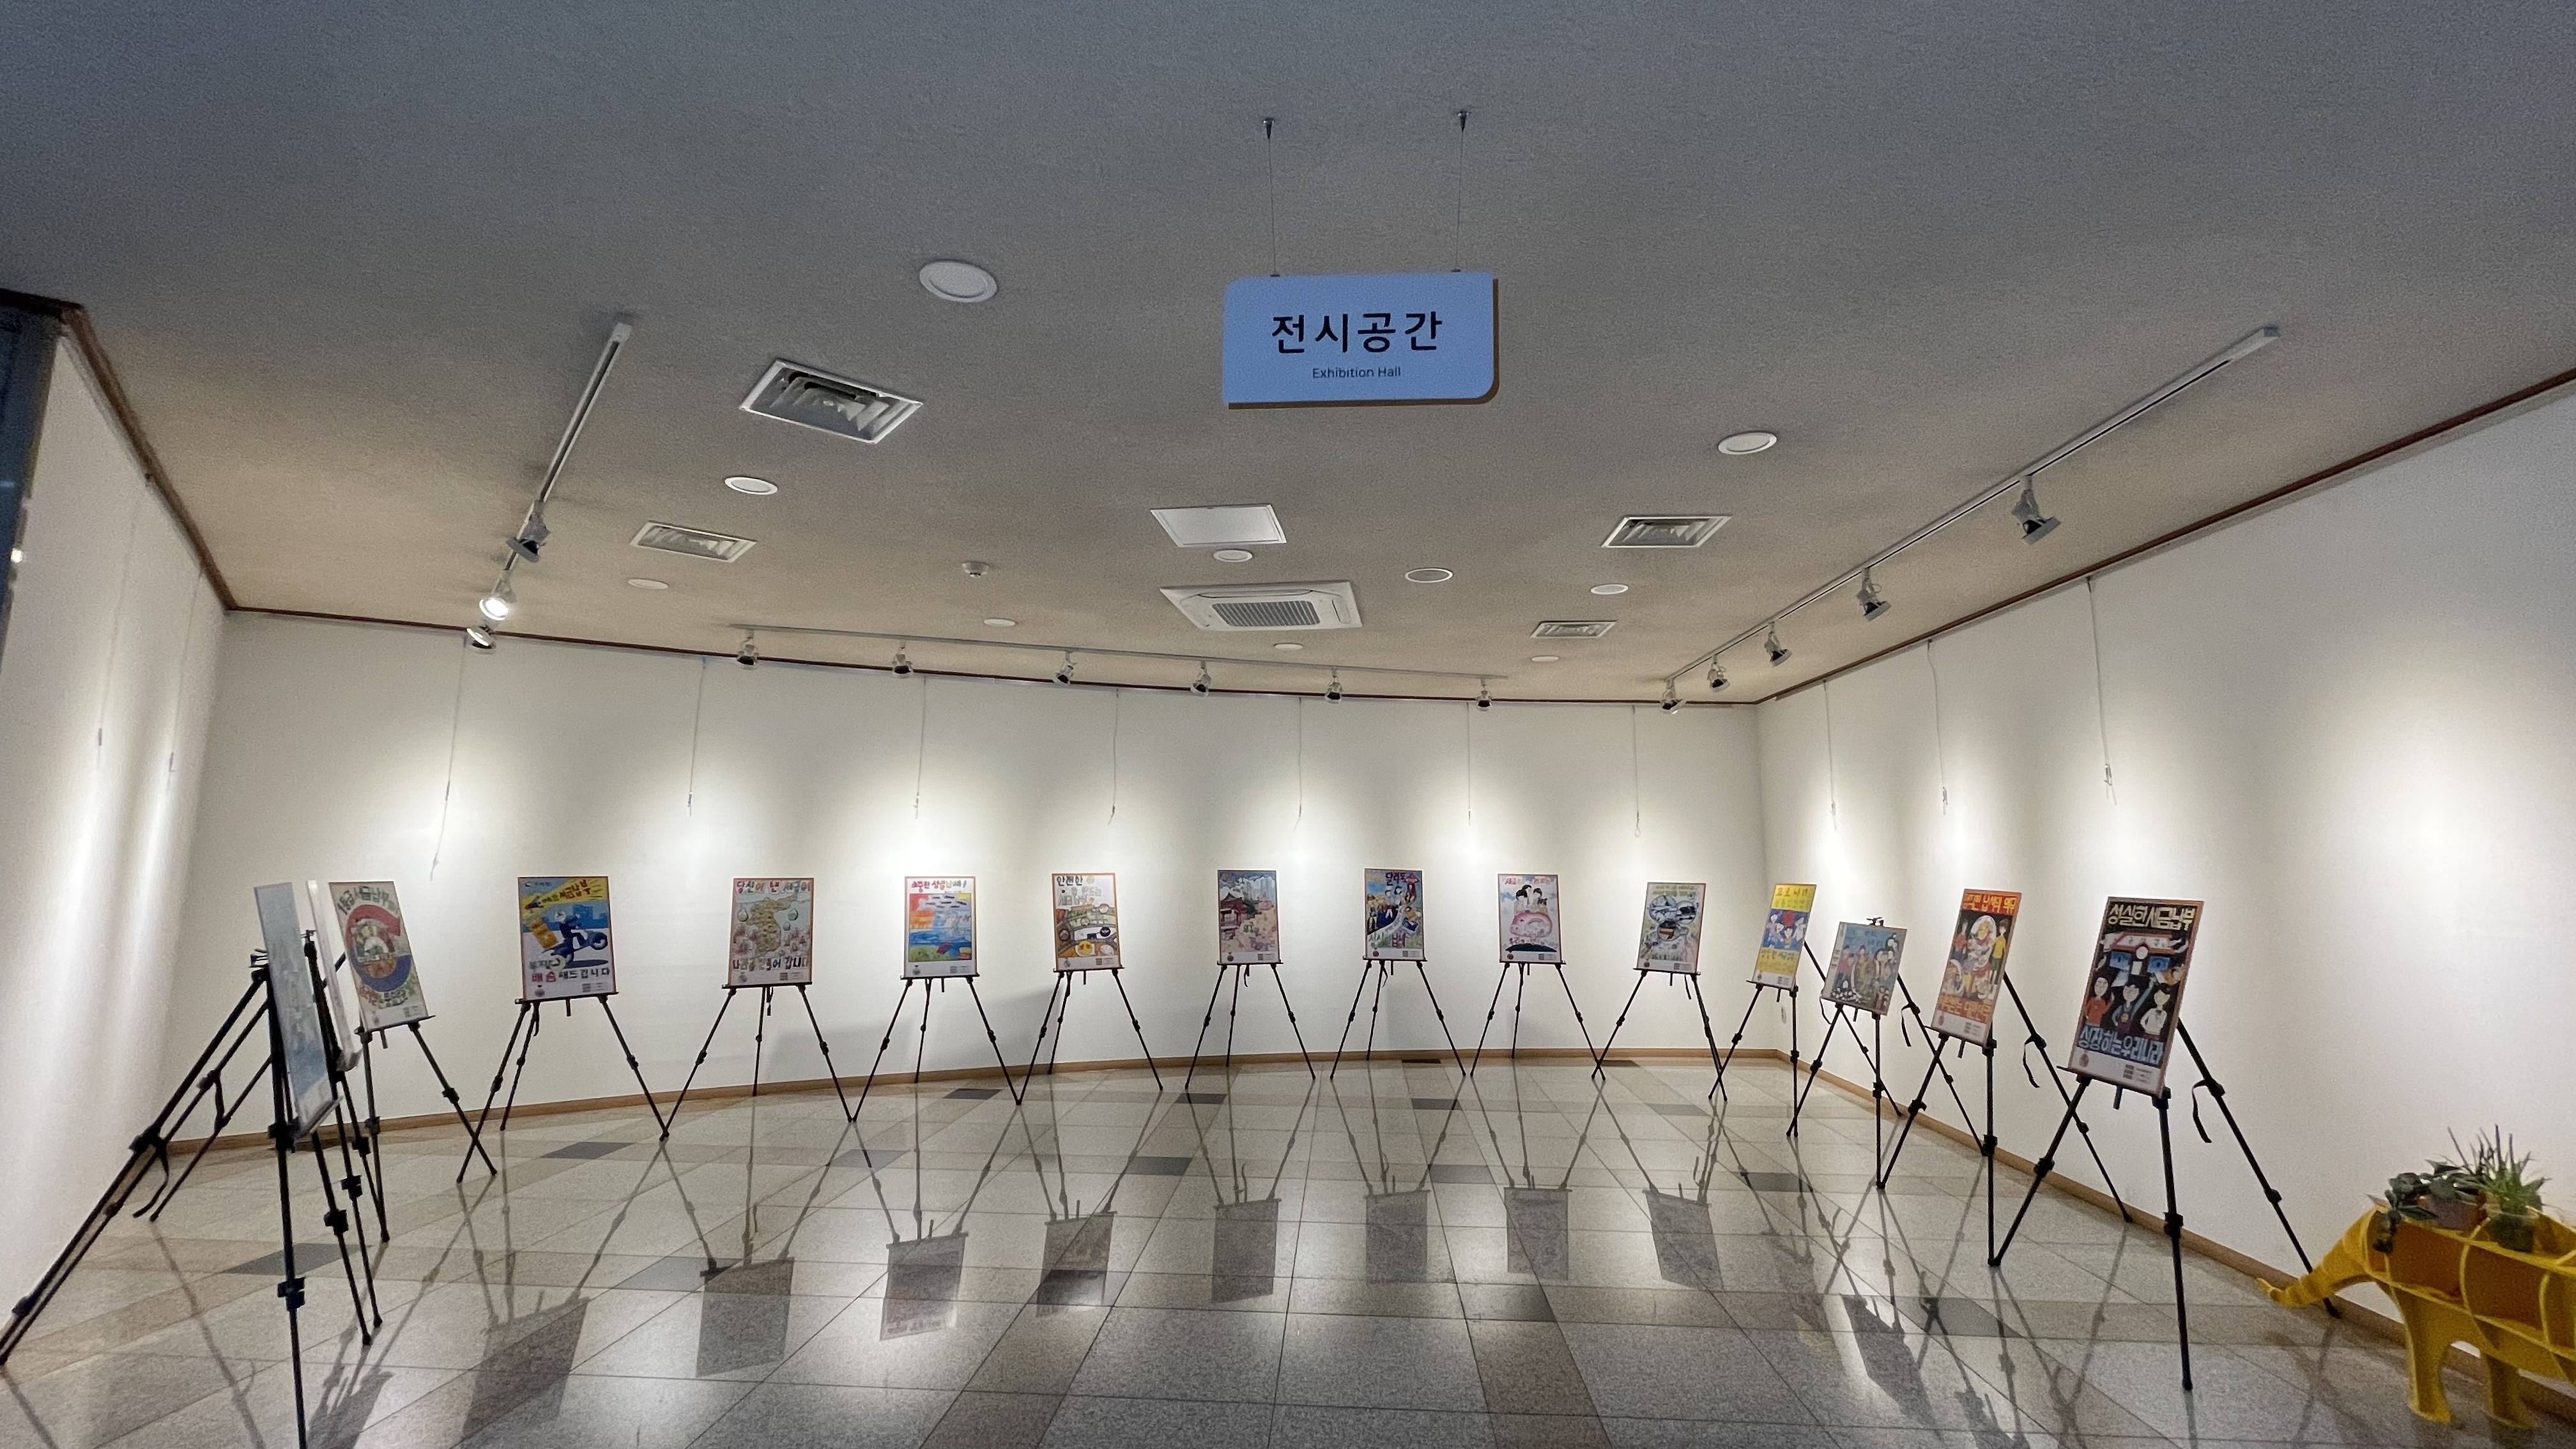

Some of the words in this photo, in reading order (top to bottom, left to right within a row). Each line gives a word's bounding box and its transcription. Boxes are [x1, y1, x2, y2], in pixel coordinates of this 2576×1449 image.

[1271, 311, 1443, 353] 전시공간
[1312, 367, 1374, 378] Exhibition
[1377, 366, 1401, 378] Hall
